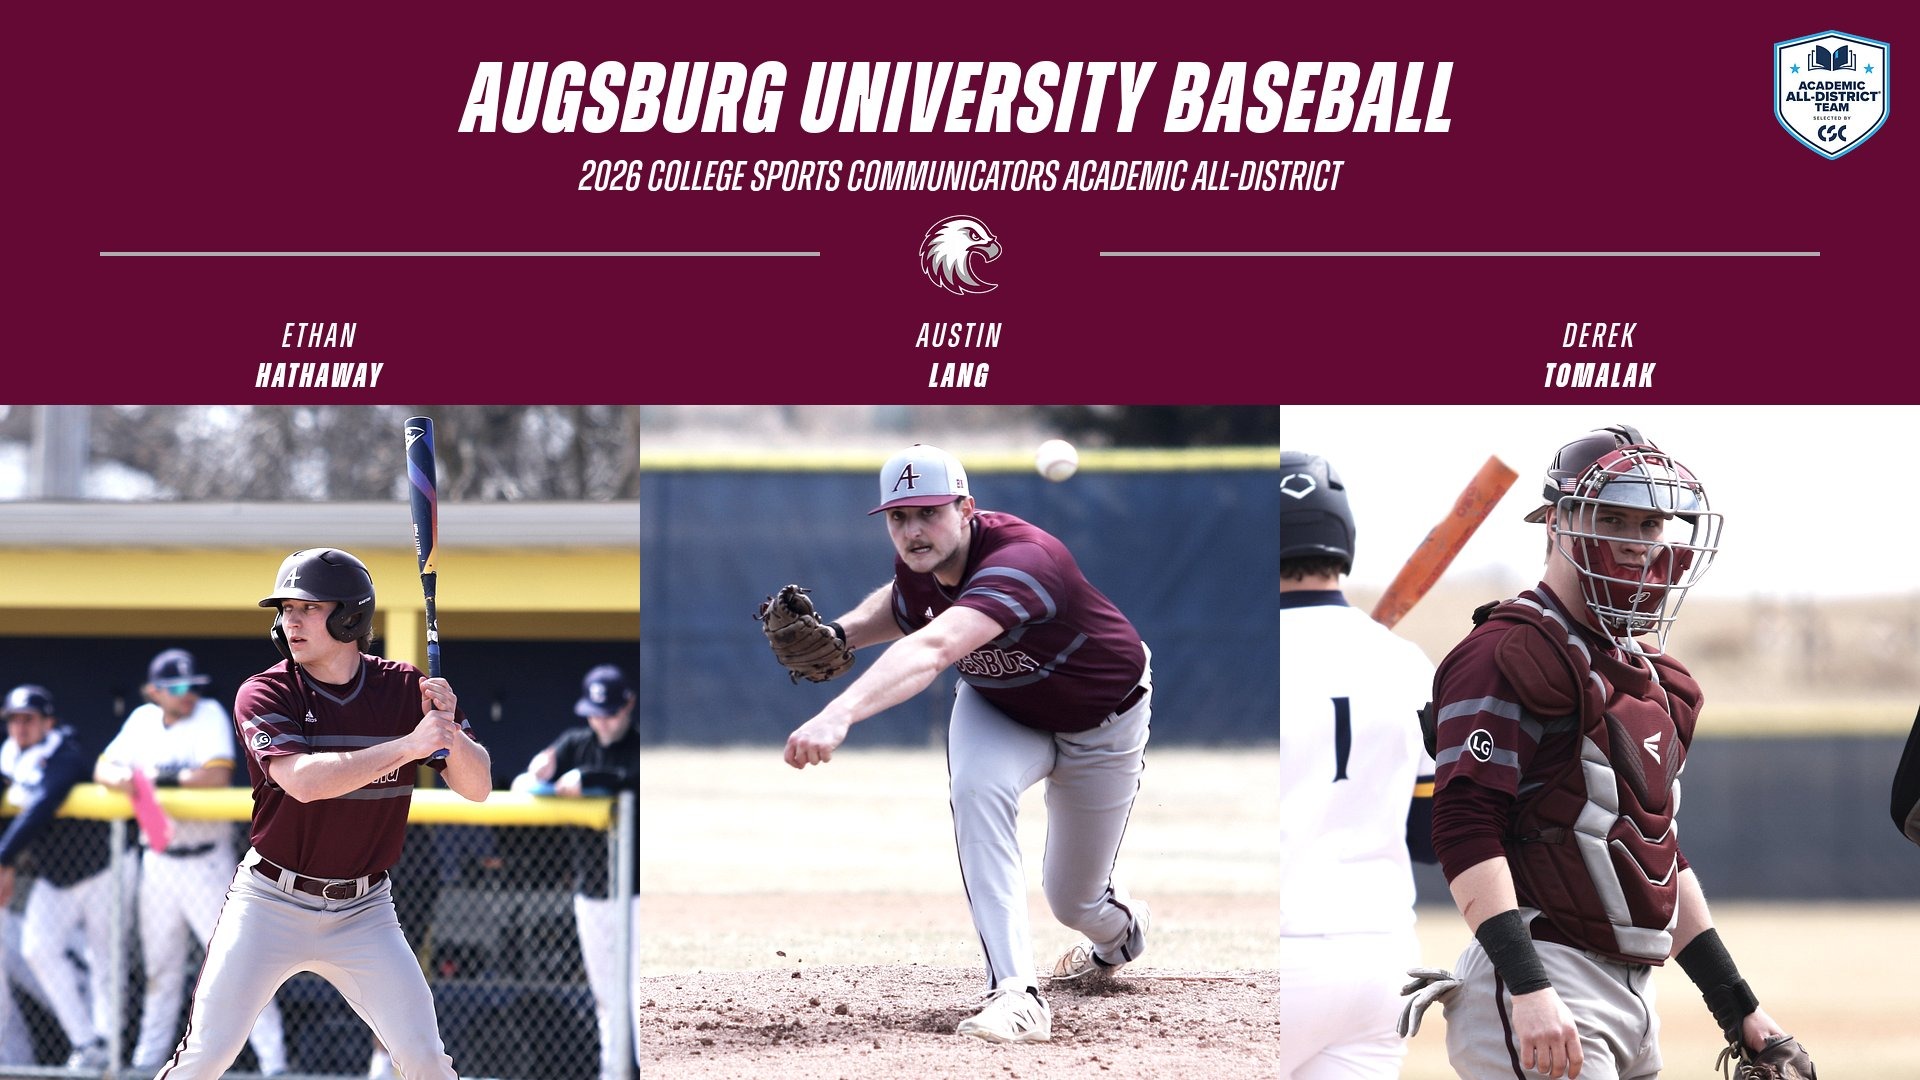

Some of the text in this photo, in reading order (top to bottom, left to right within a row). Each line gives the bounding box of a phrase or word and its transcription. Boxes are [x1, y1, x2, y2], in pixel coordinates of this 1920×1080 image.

[253, 735, 270, 748] LG
[1330, 696, 1352, 783] 1
[1472, 735, 1491, 756] LG
